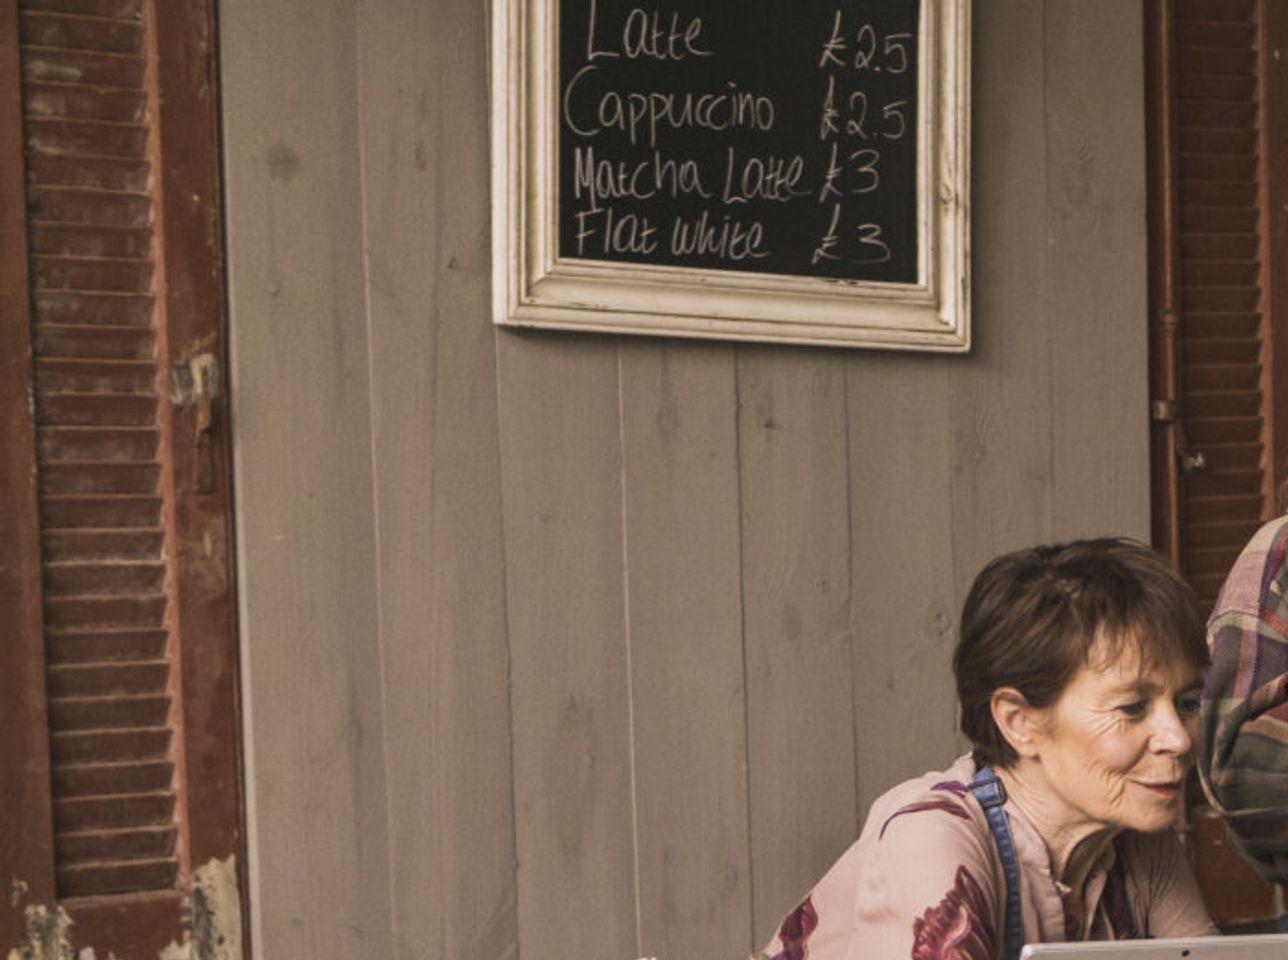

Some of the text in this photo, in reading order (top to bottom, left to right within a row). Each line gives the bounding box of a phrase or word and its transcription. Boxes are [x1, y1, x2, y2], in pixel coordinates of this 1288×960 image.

[586, 0, 715, 61] Latte
[563, 64, 775, 148] Cappuccino
[574, 146, 712, 211] Matcha
[723, 147, 813, 204] Latte
[575, 206, 658, 255] Flat
